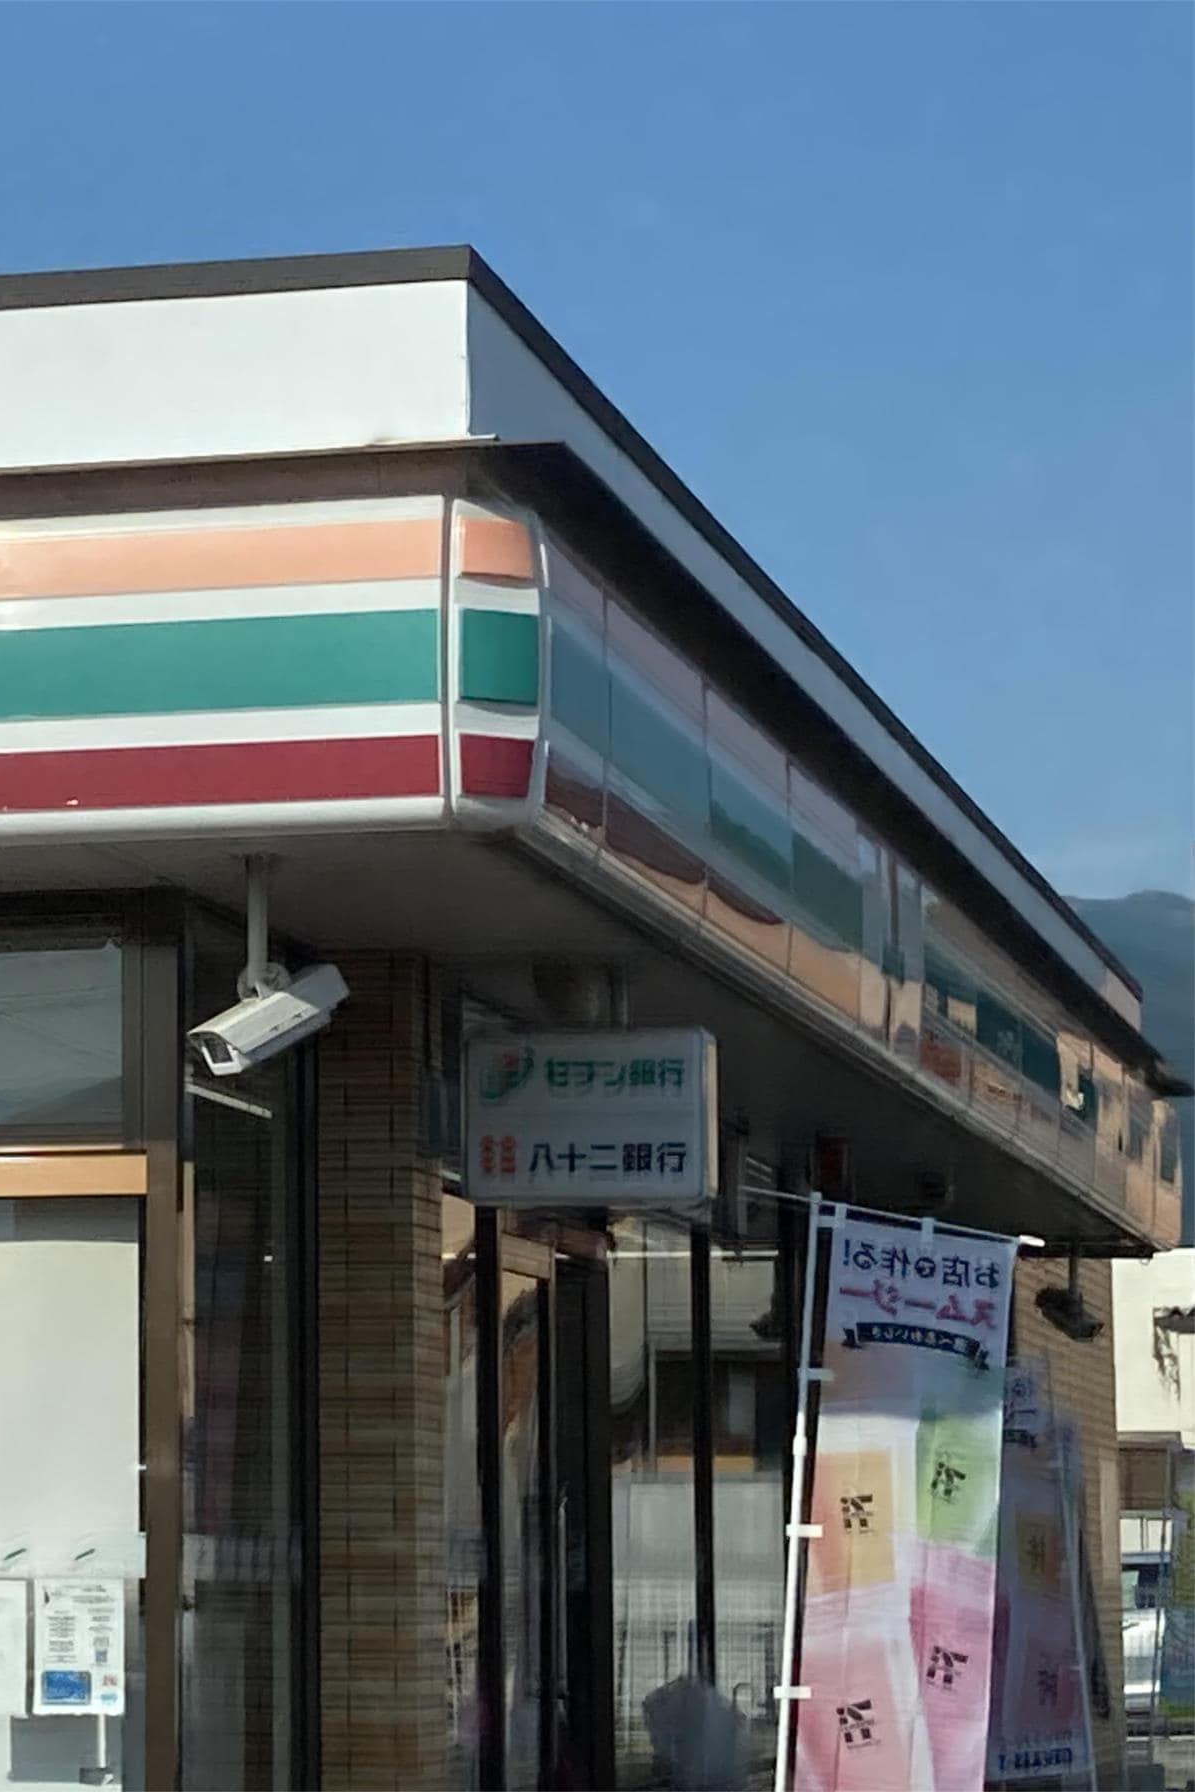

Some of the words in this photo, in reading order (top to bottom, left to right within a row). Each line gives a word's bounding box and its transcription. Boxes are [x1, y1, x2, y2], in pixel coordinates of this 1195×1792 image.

[545, 1058, 685, 1089] セブン銀行
[529, 1142, 687, 1174] 八十二銀行
